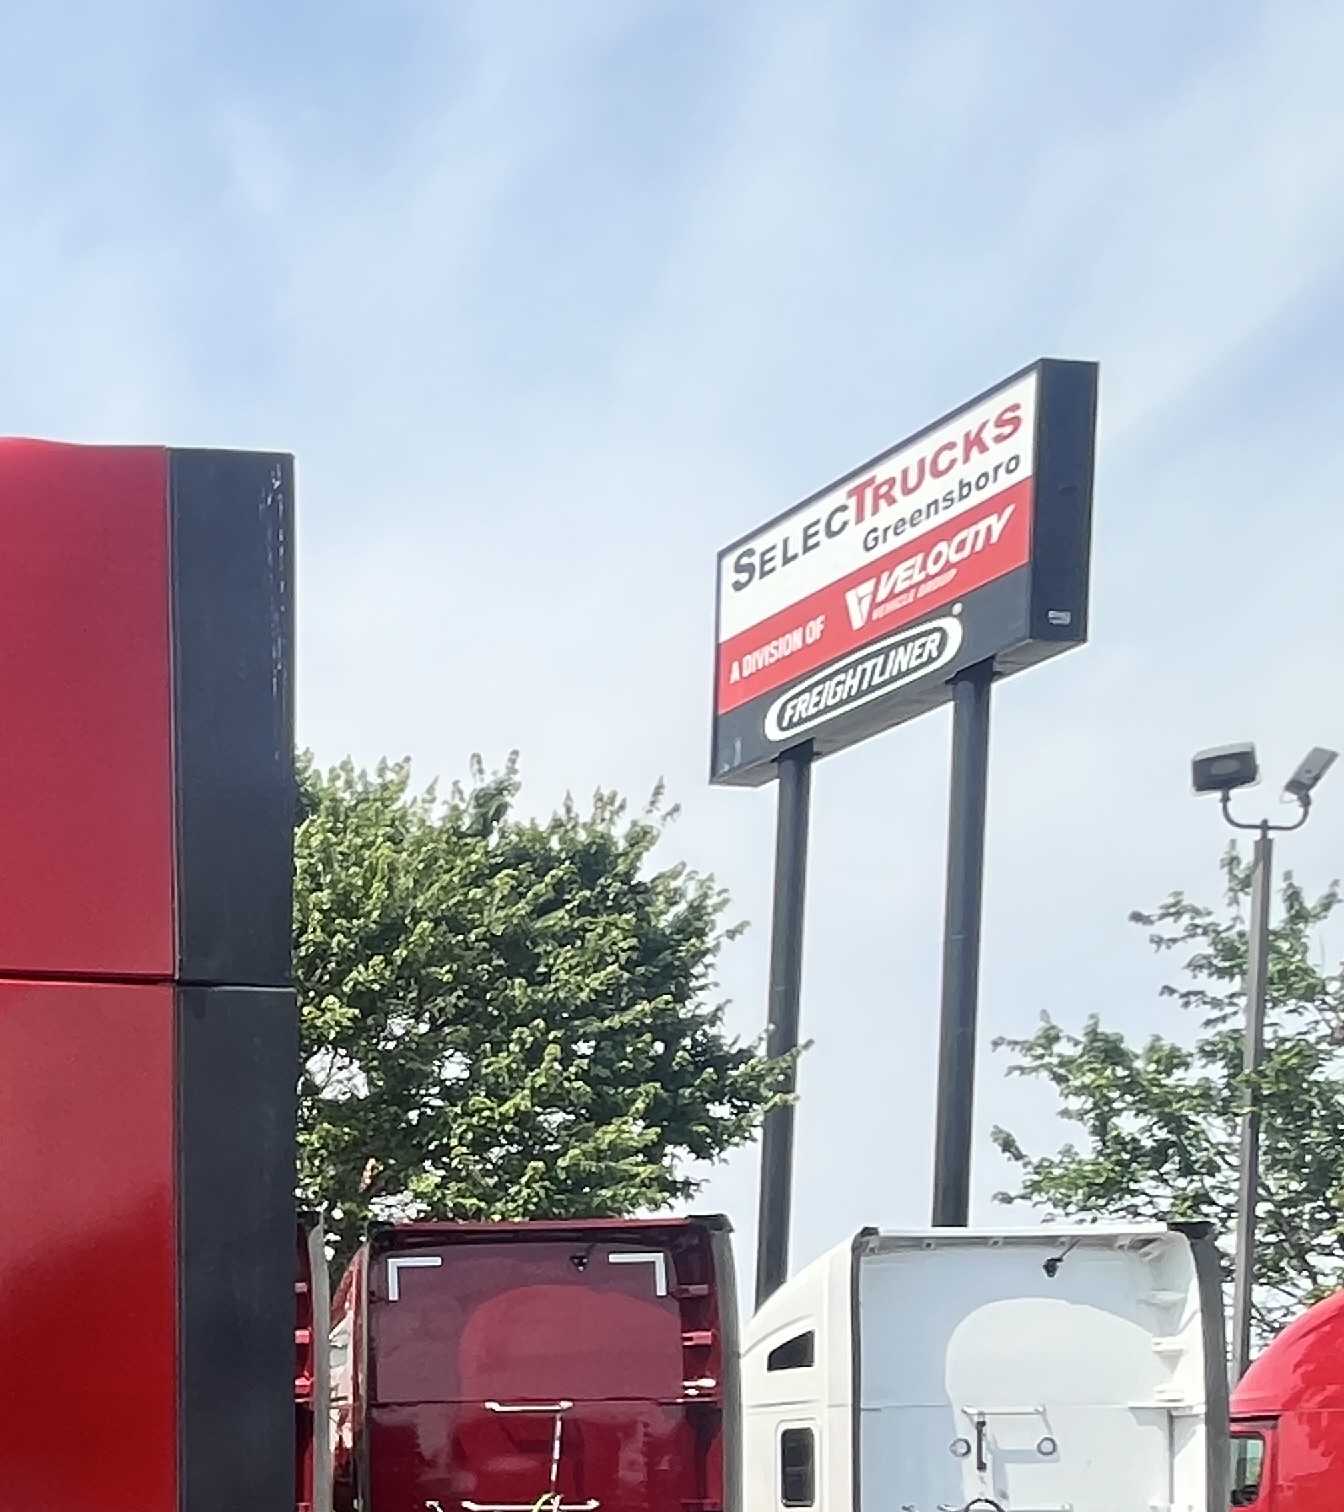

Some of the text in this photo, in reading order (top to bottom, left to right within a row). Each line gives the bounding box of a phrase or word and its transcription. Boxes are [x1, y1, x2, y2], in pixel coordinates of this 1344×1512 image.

[863, 454, 1020, 552] Greensboro
[875, 502, 1016, 604] VELOCITY
[729, 614, 825, 684] A DIVISION OF
[782, 632, 942, 728] FREIGHTLINER
